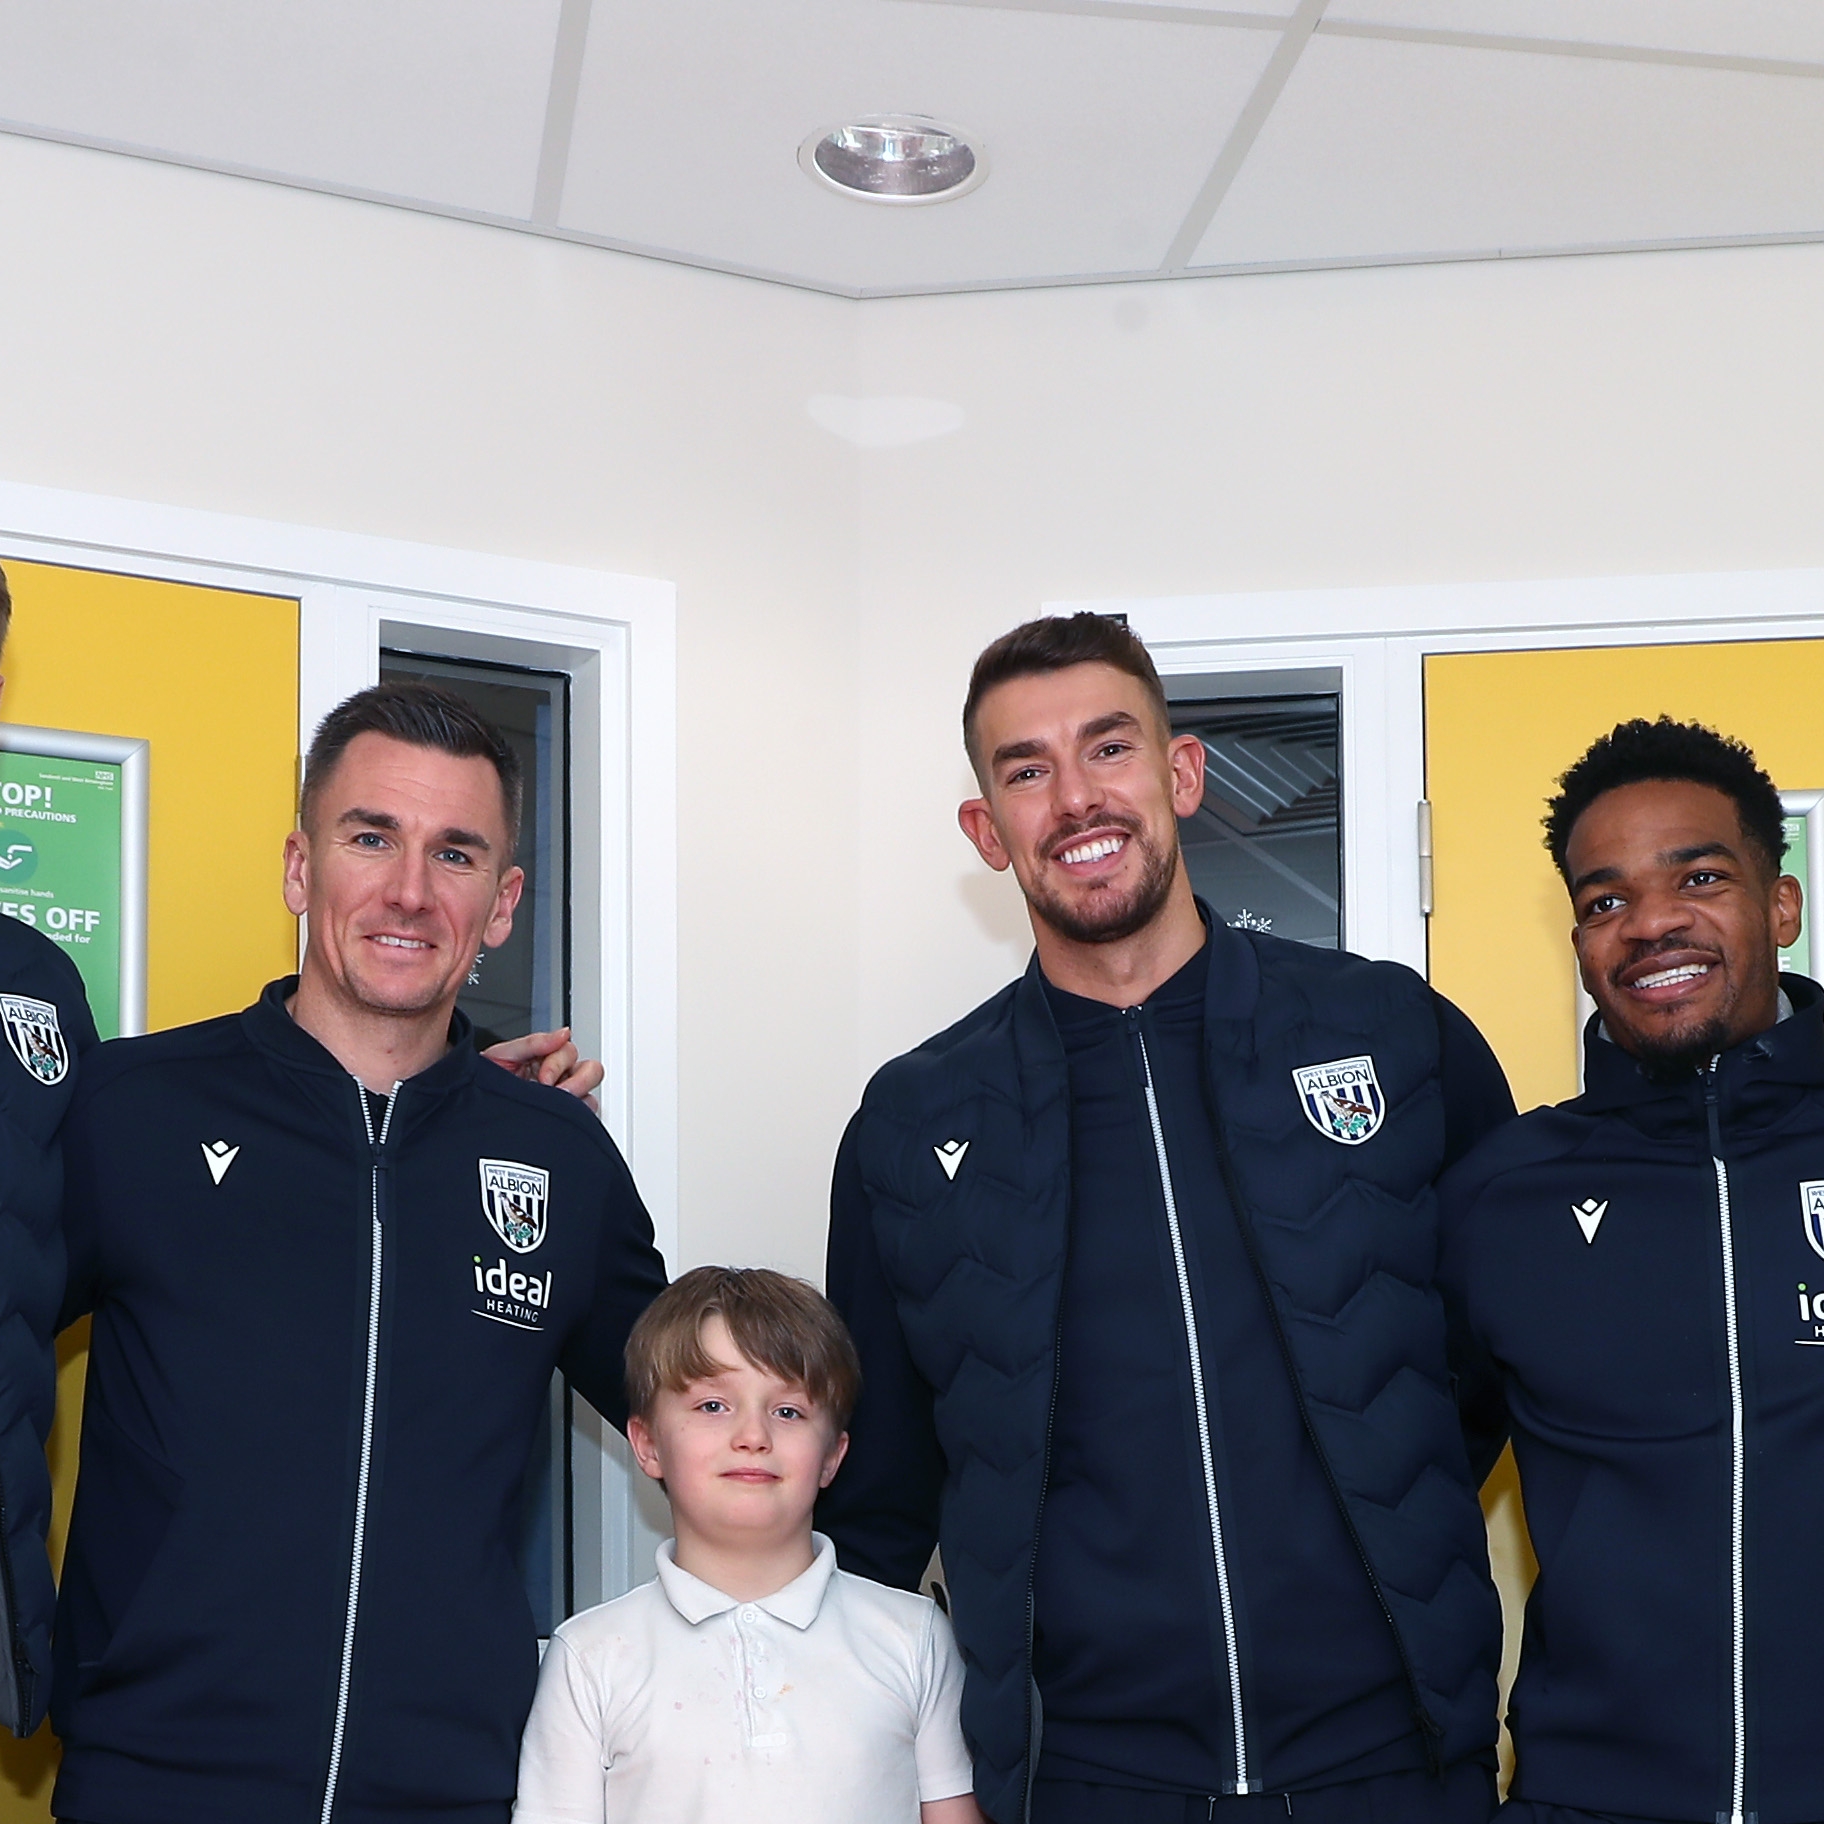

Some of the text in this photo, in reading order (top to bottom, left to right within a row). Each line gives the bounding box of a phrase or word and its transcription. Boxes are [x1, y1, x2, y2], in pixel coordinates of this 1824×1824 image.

[4, 807, 76, 824] PRECAUTIONS
[30, 889, 54, 898] hands
[46, 907, 101, 932] OFF
[74, 934, 91, 944] for
[9, 1007, 56, 1028] ALBION
[1307, 1068, 1370, 1091] ALBION
[490, 1176, 542, 1196] ALBION
[473, 1255, 552, 1309] ideal
[486, 1299, 539, 1323] HEATING
